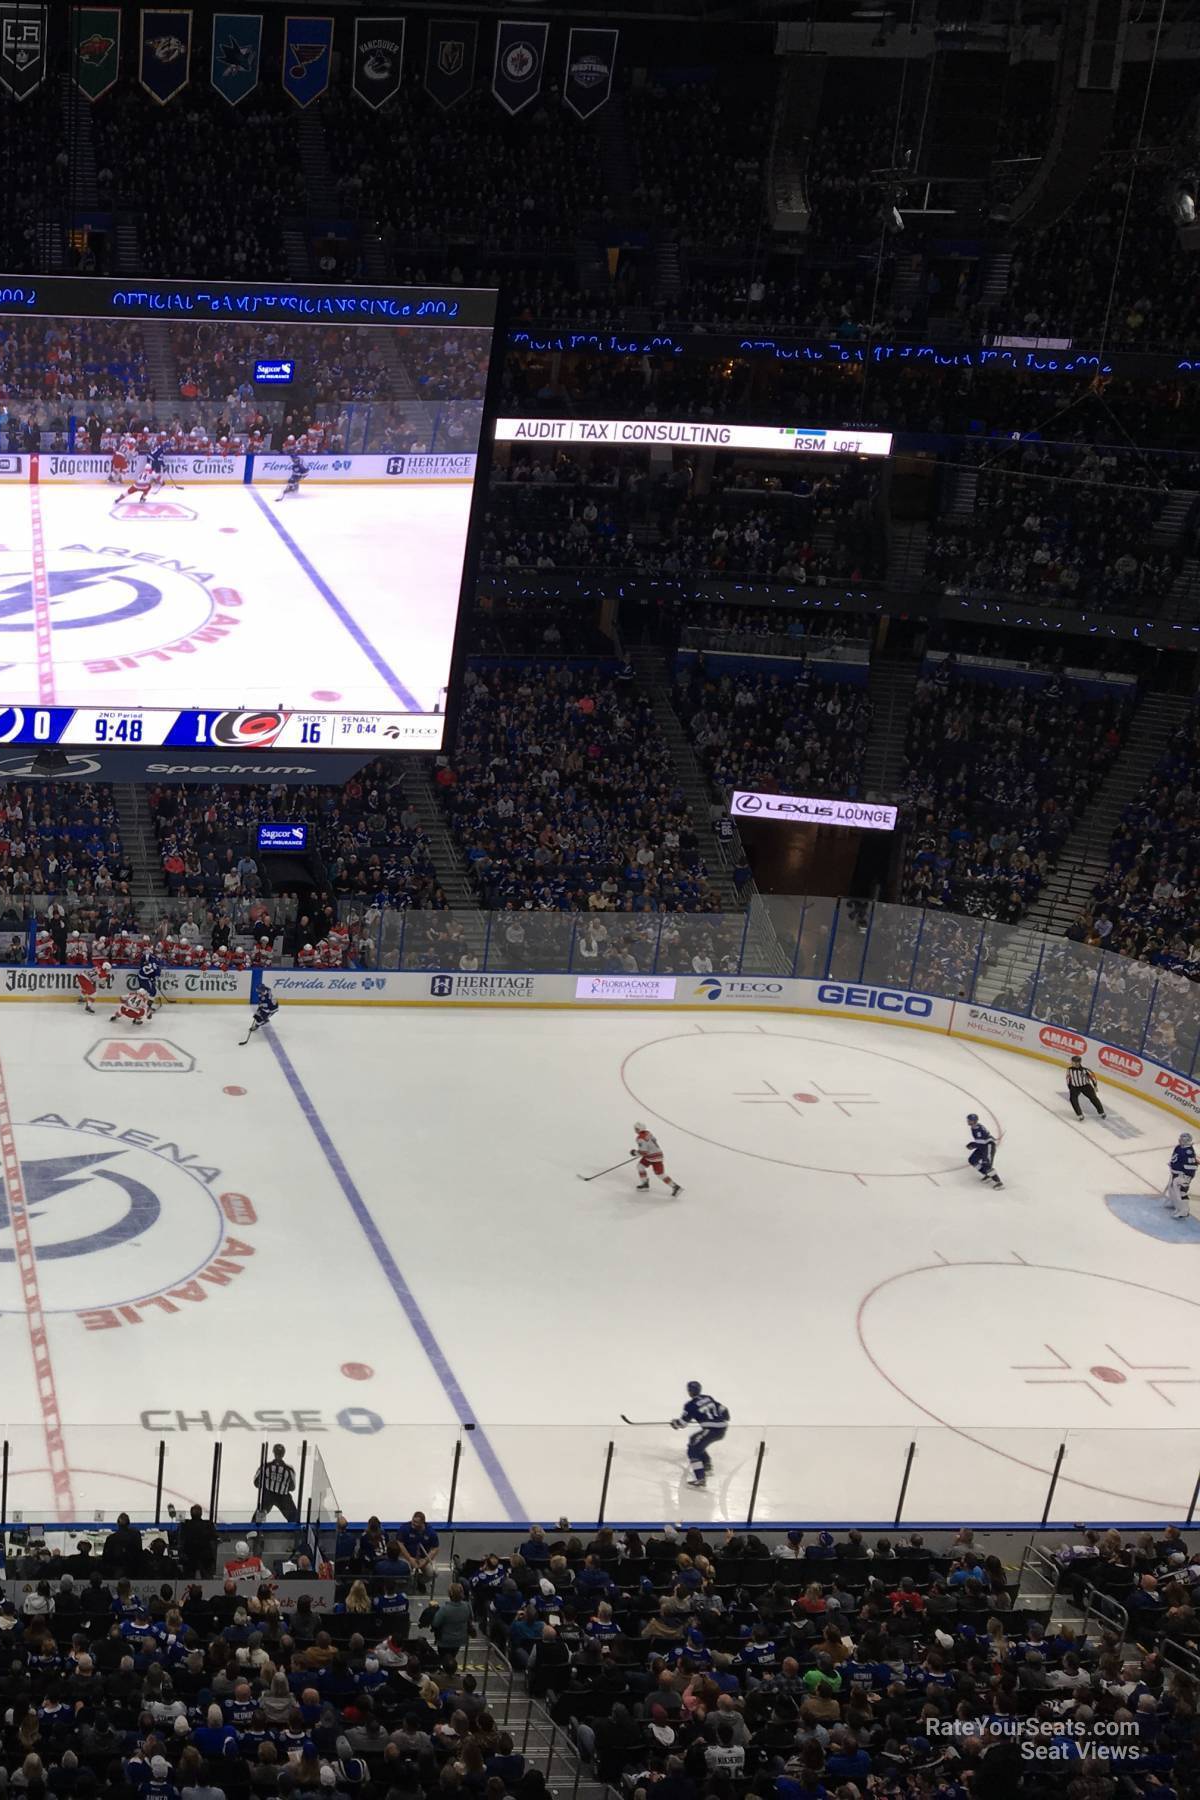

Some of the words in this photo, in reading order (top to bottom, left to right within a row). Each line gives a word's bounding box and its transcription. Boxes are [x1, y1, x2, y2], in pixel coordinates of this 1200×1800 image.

[514, 421, 565, 439] AUDIT
[578, 423, 609, 439] TAX
[621, 424, 732, 443] CONSULTING
[793, 437, 826, 451] RSM
[408, 456, 472, 467] HERITAGE
[296, 715, 327, 723] SHOTS
[341, 716, 381, 724] PENALTY
[95, 719, 143, 743] 9:48
[195, 714, 207, 743] 1
[300, 722, 321, 744] 16
[341, 723, 351, 734] 37
[356, 724, 377, 735] 0:44
[145, 763, 309, 775] Spectrum
[765, 801, 834, 816] LEXUS
[836, 807, 892, 823] LOUNGE
[260, 828, 291, 839] Sagicor
[185, 974, 238, 992] Times
[272, 978, 325, 990] Florida
[327, 979, 357, 990] Blue
[456, 976, 535, 989] HERITAGE
[725, 983, 784, 993] TECO
[455, 988, 534, 998] INSURANCE
[817, 984, 933, 1018] GEICO
[1042, 1031, 1085, 1053] AMALIE
[99, 1060, 184, 1068] MARATHON
[1101, 1050, 1141, 1072] AMALIE
[29, 1111, 222, 1185] ARENA
[76, 1236, 257, 1332] AMALIE
[140, 1409, 327, 1433] CHASE
